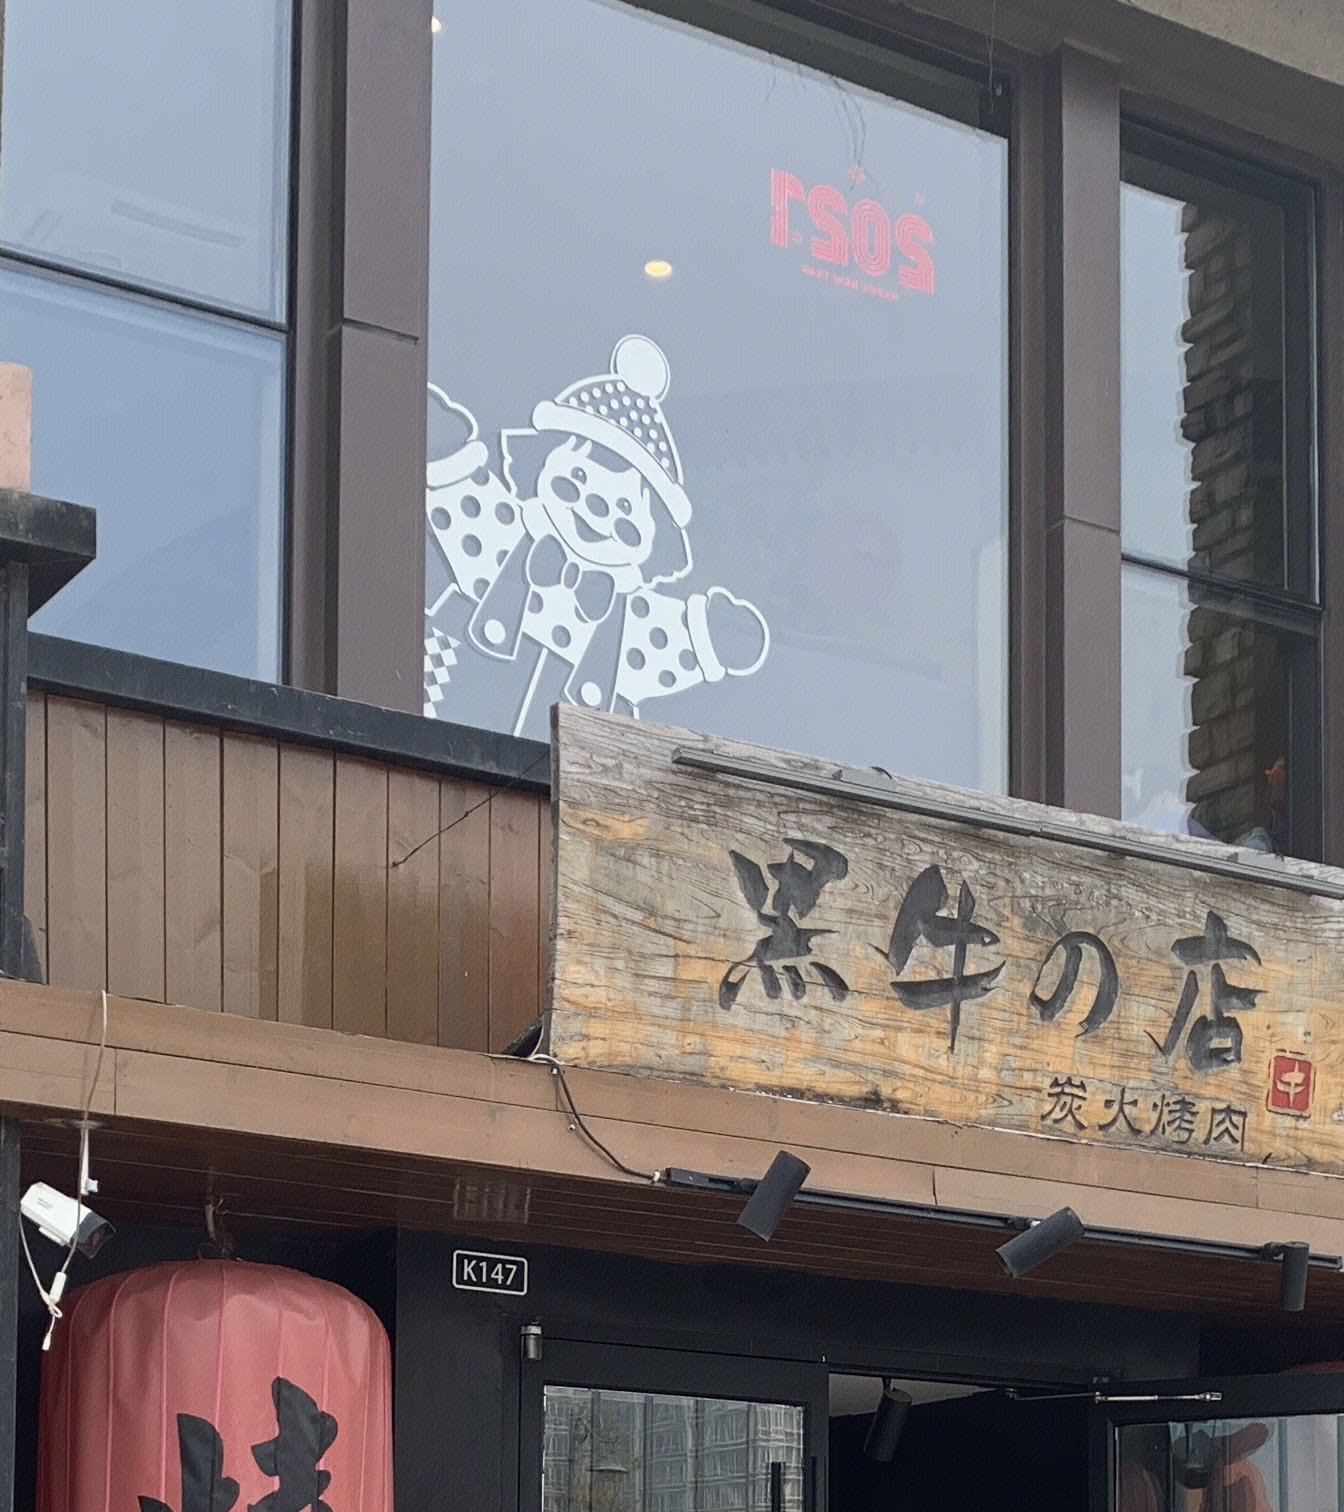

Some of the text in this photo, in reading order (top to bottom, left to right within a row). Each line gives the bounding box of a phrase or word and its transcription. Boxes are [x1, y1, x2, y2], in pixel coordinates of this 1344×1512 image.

[1040, 1076, 1248, 1152] 炭火烤肉
[463, 1258, 518, 1286] K147
